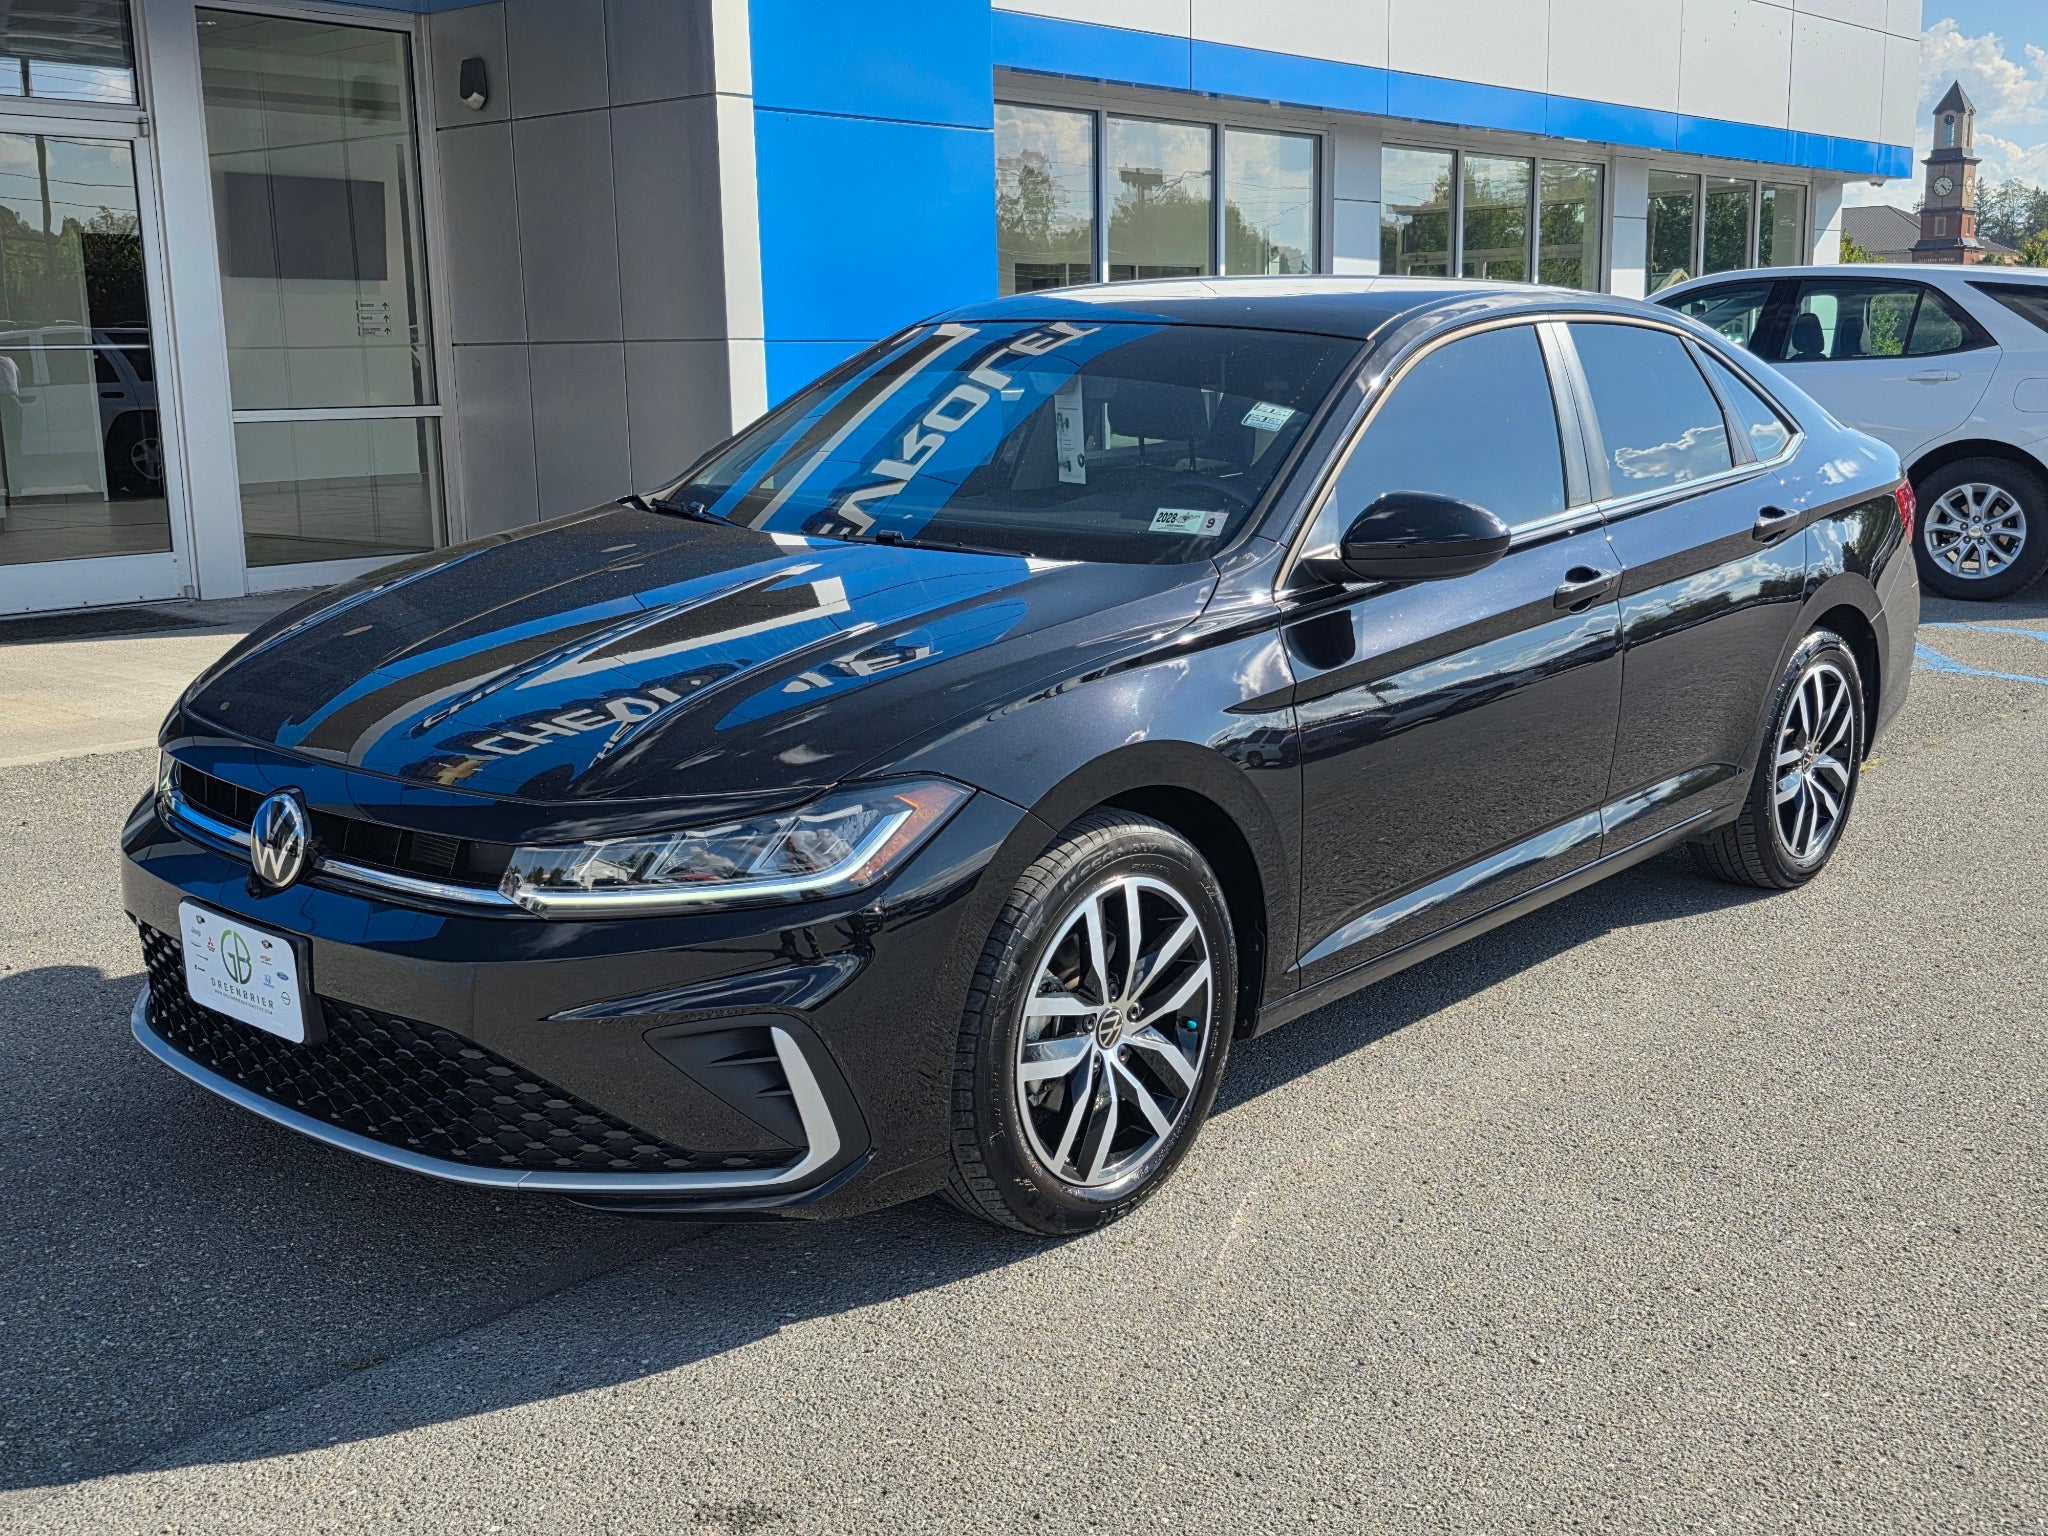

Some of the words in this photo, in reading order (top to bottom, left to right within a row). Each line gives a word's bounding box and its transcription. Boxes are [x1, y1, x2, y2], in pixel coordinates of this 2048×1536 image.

[1156, 512, 1178, 523] 2028
[1206, 518, 1215, 528] 9
[211, 977, 275, 1010] GREENBRIER
